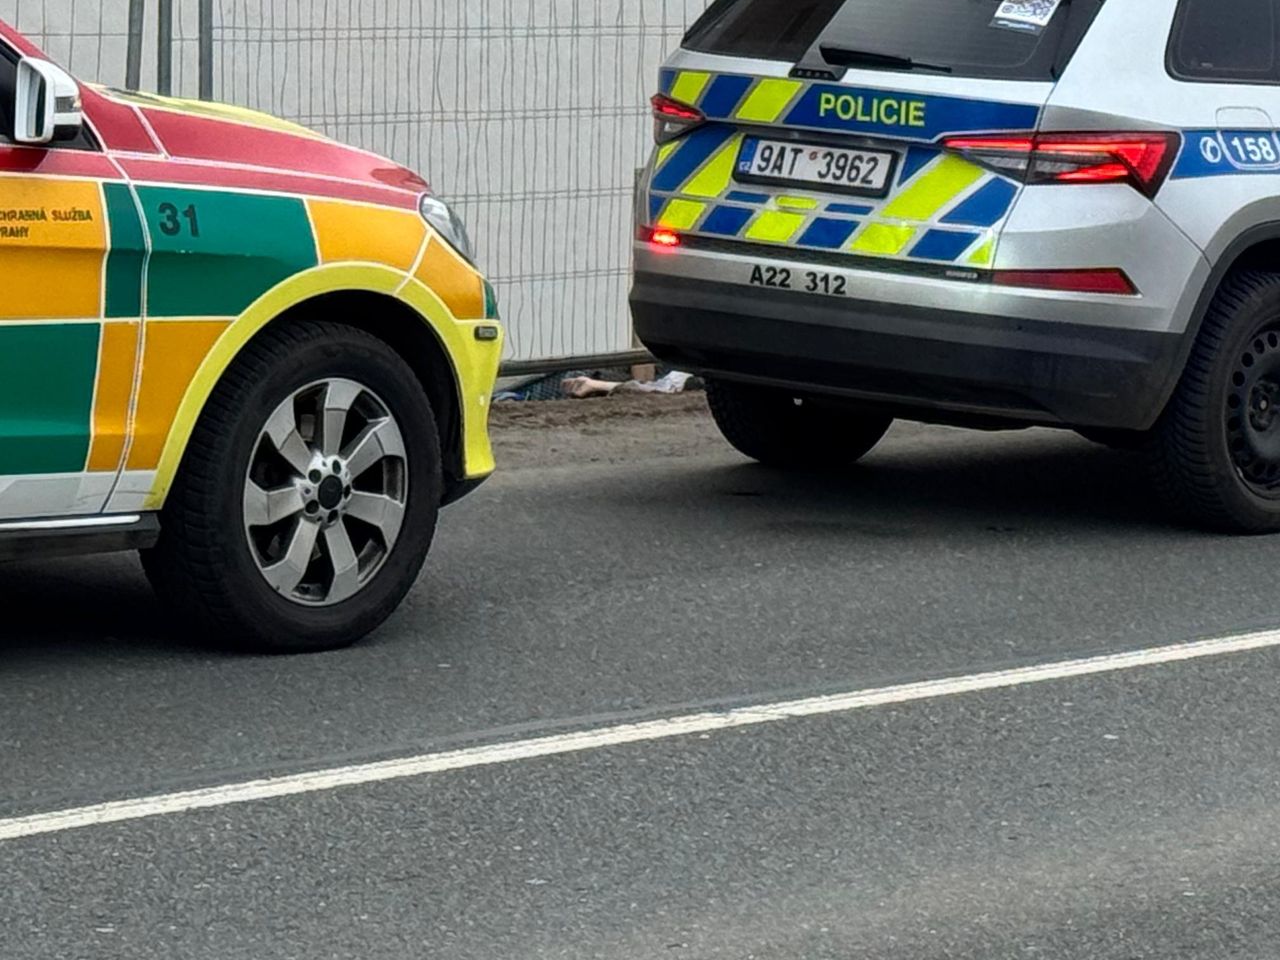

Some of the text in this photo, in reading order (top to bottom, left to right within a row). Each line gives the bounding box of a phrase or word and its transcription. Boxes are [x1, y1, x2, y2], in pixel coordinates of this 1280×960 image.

[819, 93, 926, 127] POLICIE
[1231, 136, 1277, 162] 158
[757, 144, 879, 186] 9AT 3962
[51, 206, 93, 222] SLUŽBA
[158, 201, 201, 238] 31
[0, 225, 30, 239] RAHY
[749, 264, 847, 295] A22 312
